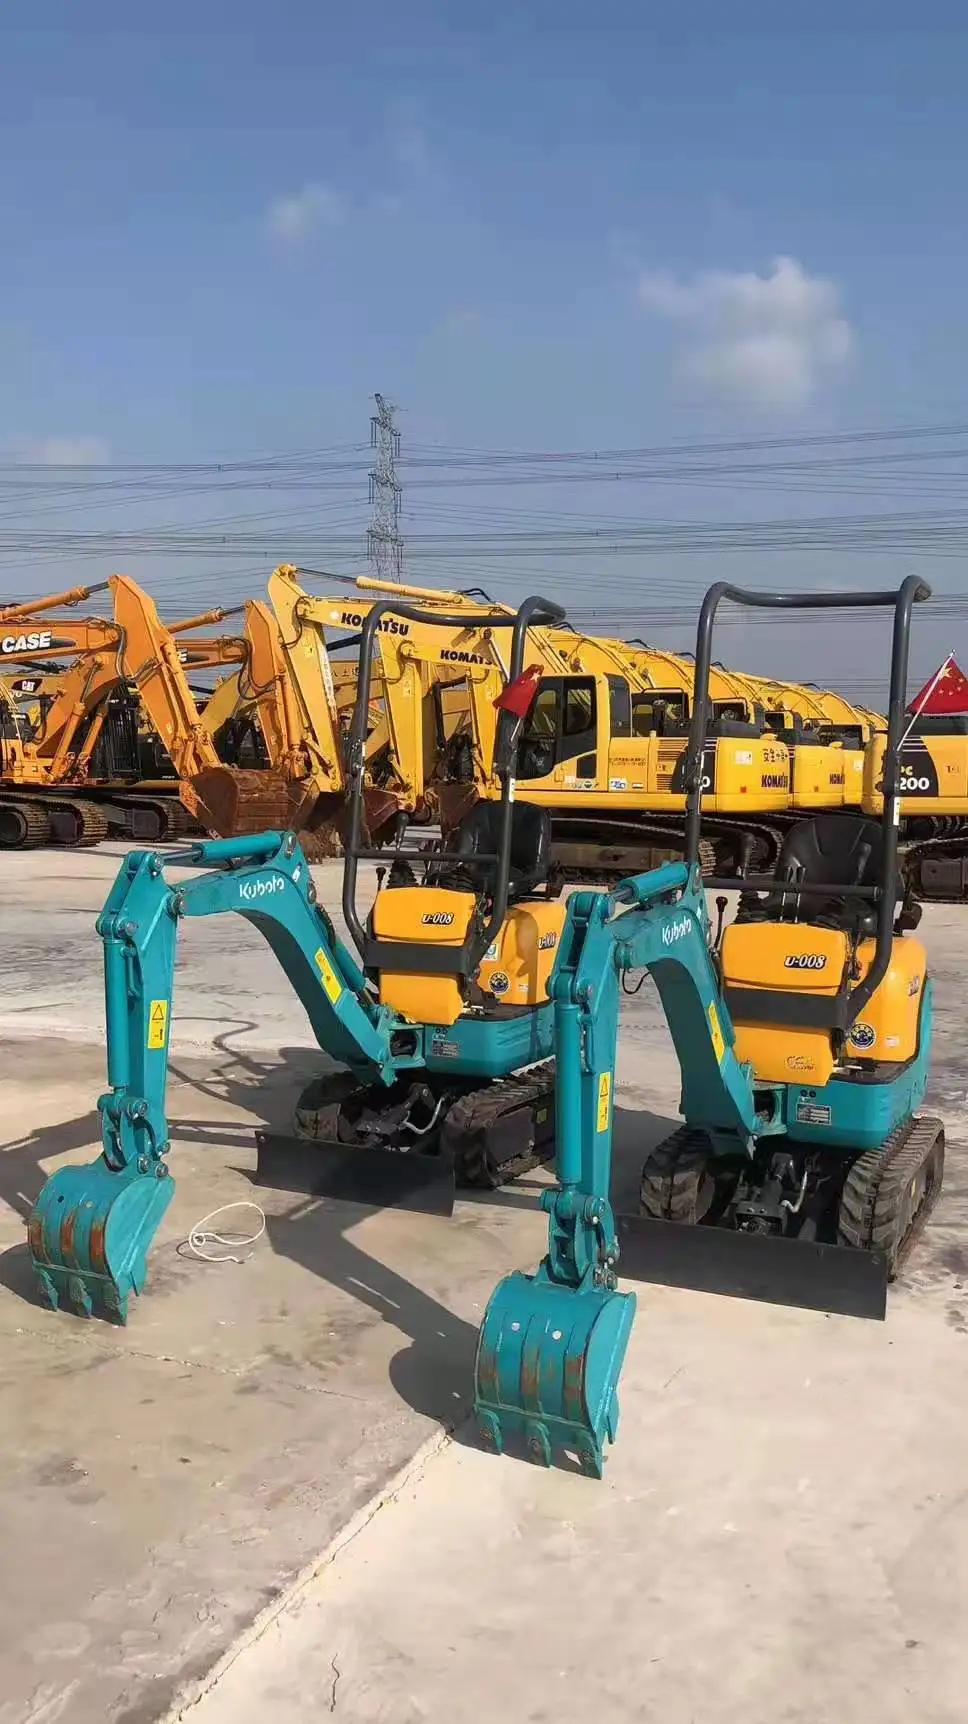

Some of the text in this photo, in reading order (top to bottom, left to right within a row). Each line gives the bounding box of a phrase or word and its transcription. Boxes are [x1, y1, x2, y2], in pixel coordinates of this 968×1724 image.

[341, 612, 409, 636] KOATSU
[2, 631, 52, 653] CASE
[21, 680, 36, 692] CAT
[900, 777, 930, 791] 200
[239, 875, 285, 900] Kubota
[422, 912, 454, 924] U-008
[662, 915, 692, 946] Kubota
[784, 954, 826, 969] U-008
